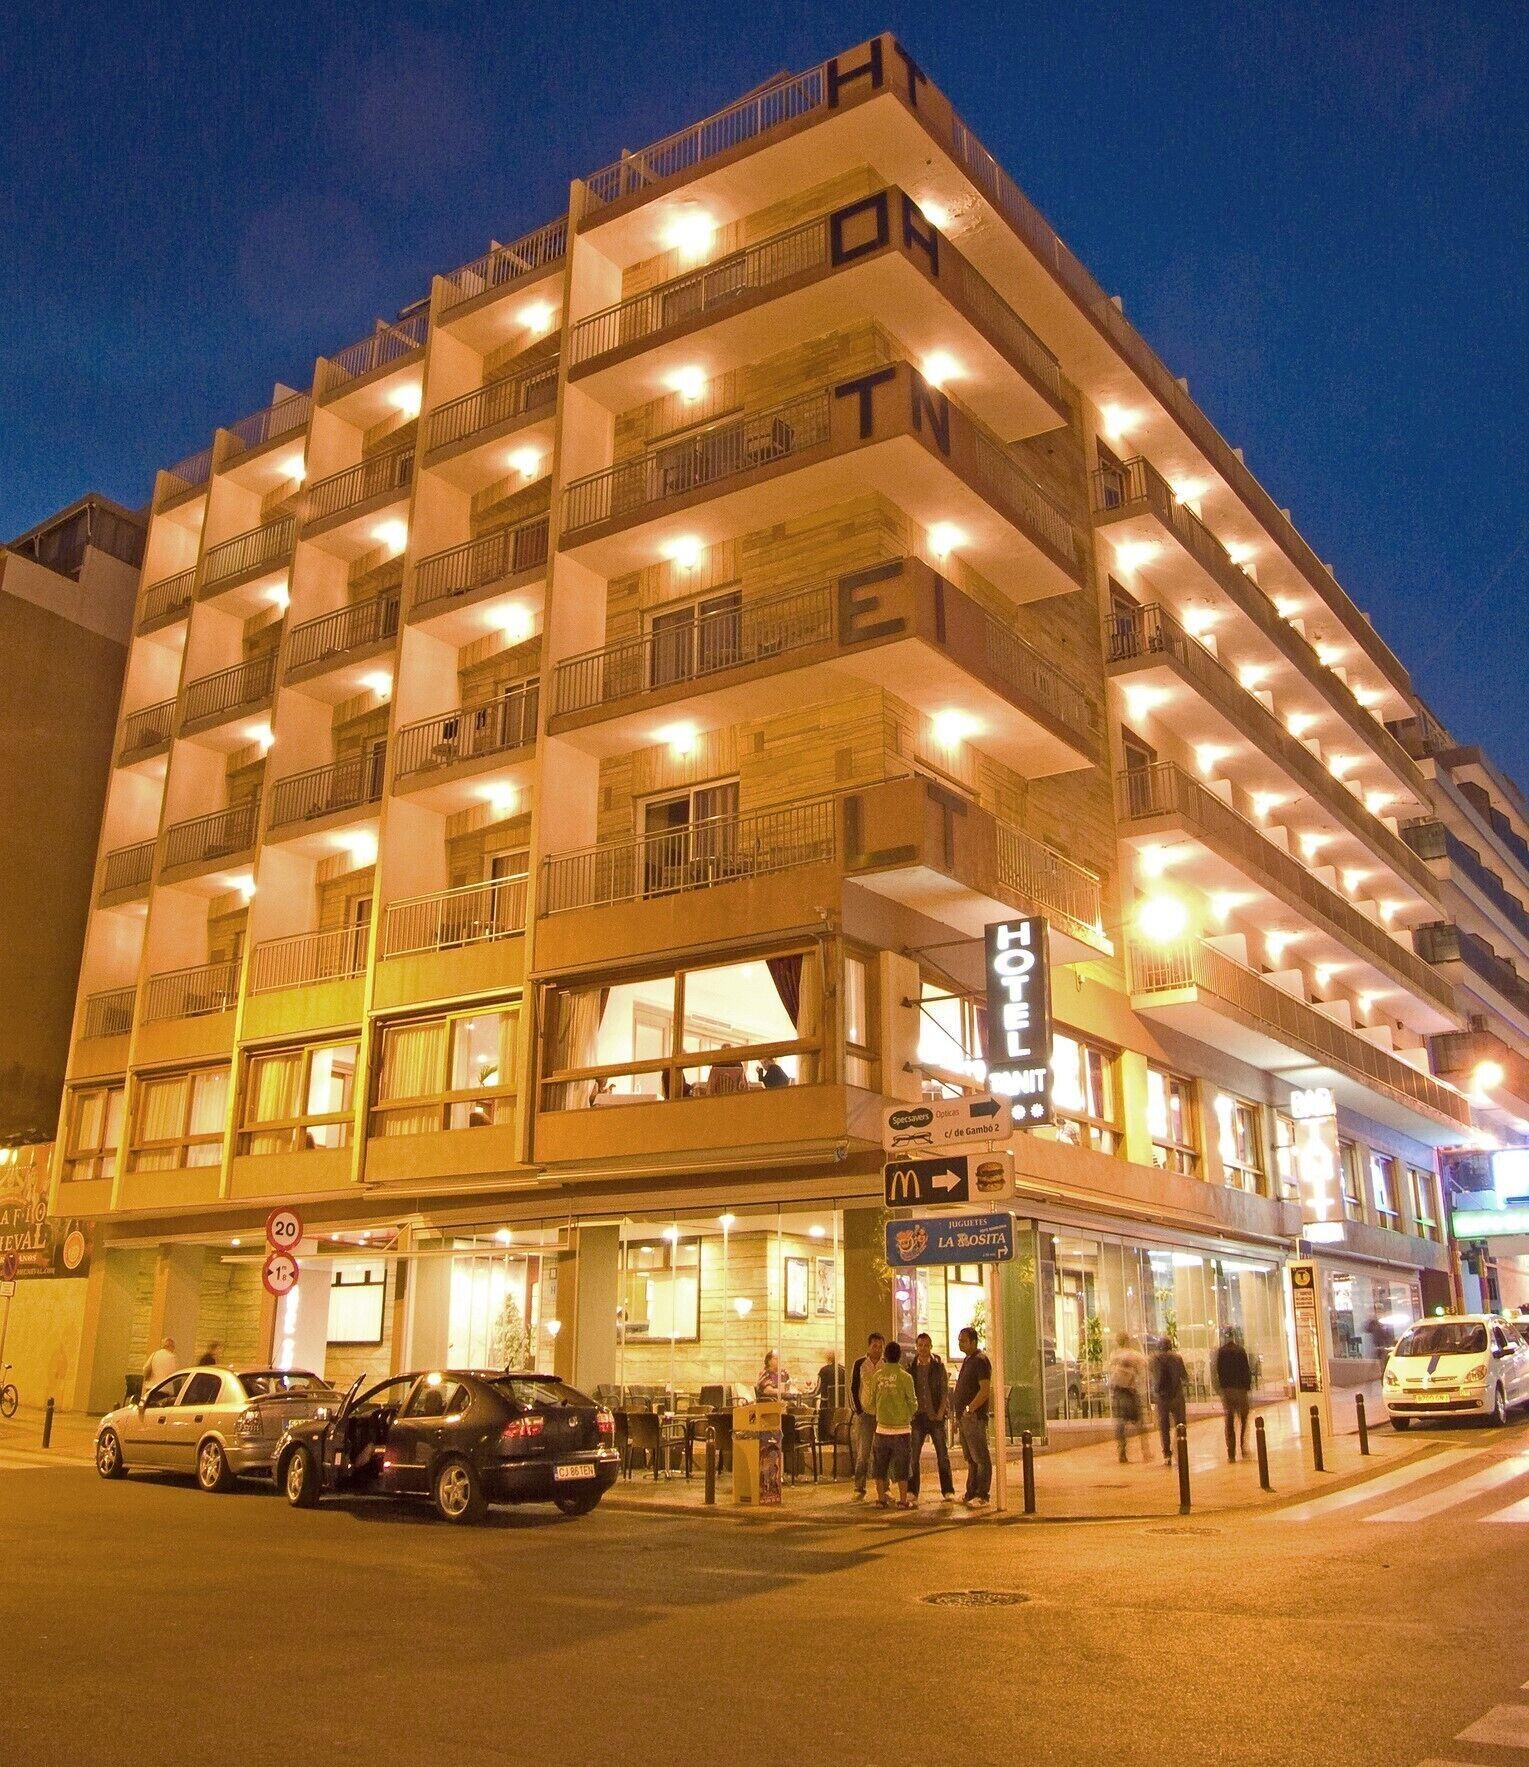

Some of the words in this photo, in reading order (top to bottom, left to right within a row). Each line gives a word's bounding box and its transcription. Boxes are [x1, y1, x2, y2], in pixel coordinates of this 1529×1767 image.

[827, 37, 919, 868] HOTEL
[993, 921, 1035, 1058] HOTEL
[892, 1112, 930, 1125] Specsavers
[954, 1128, 964, 1137] de
[995, 1123, 1000, 1132] 2
[275, 1221, 297, 1237] 20
[949, 1218, 988, 1229] JUGUETES
[938, 1237, 954, 1248] LA
